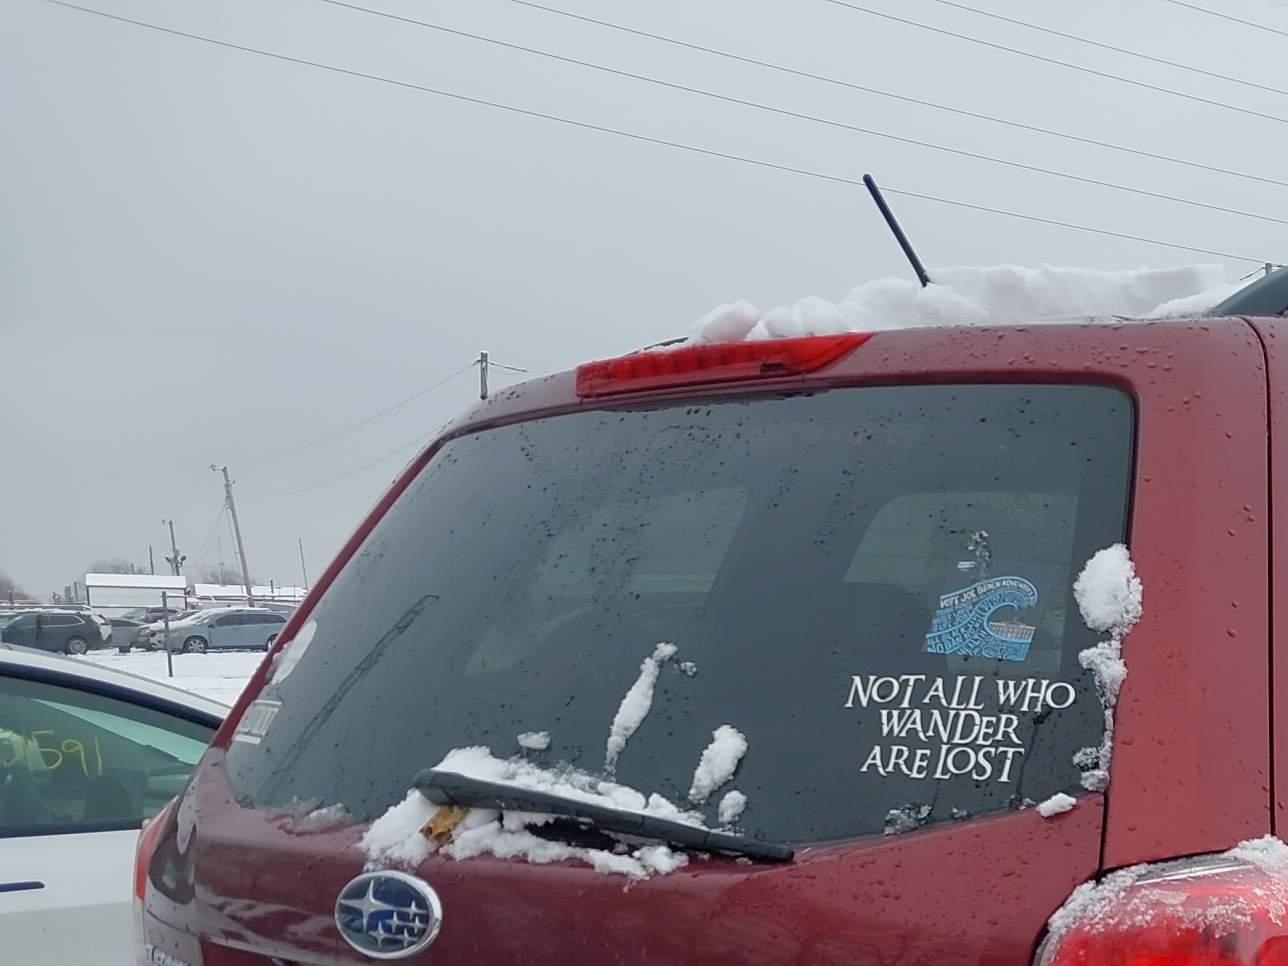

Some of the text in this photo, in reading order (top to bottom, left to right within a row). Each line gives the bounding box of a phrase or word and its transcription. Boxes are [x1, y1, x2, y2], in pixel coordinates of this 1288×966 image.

[845, 675, 1076, 712] NOT ALL WHO
[880, 709, 1023, 745] WANDER
[860, 745, 1025, 783] ARE LOST
